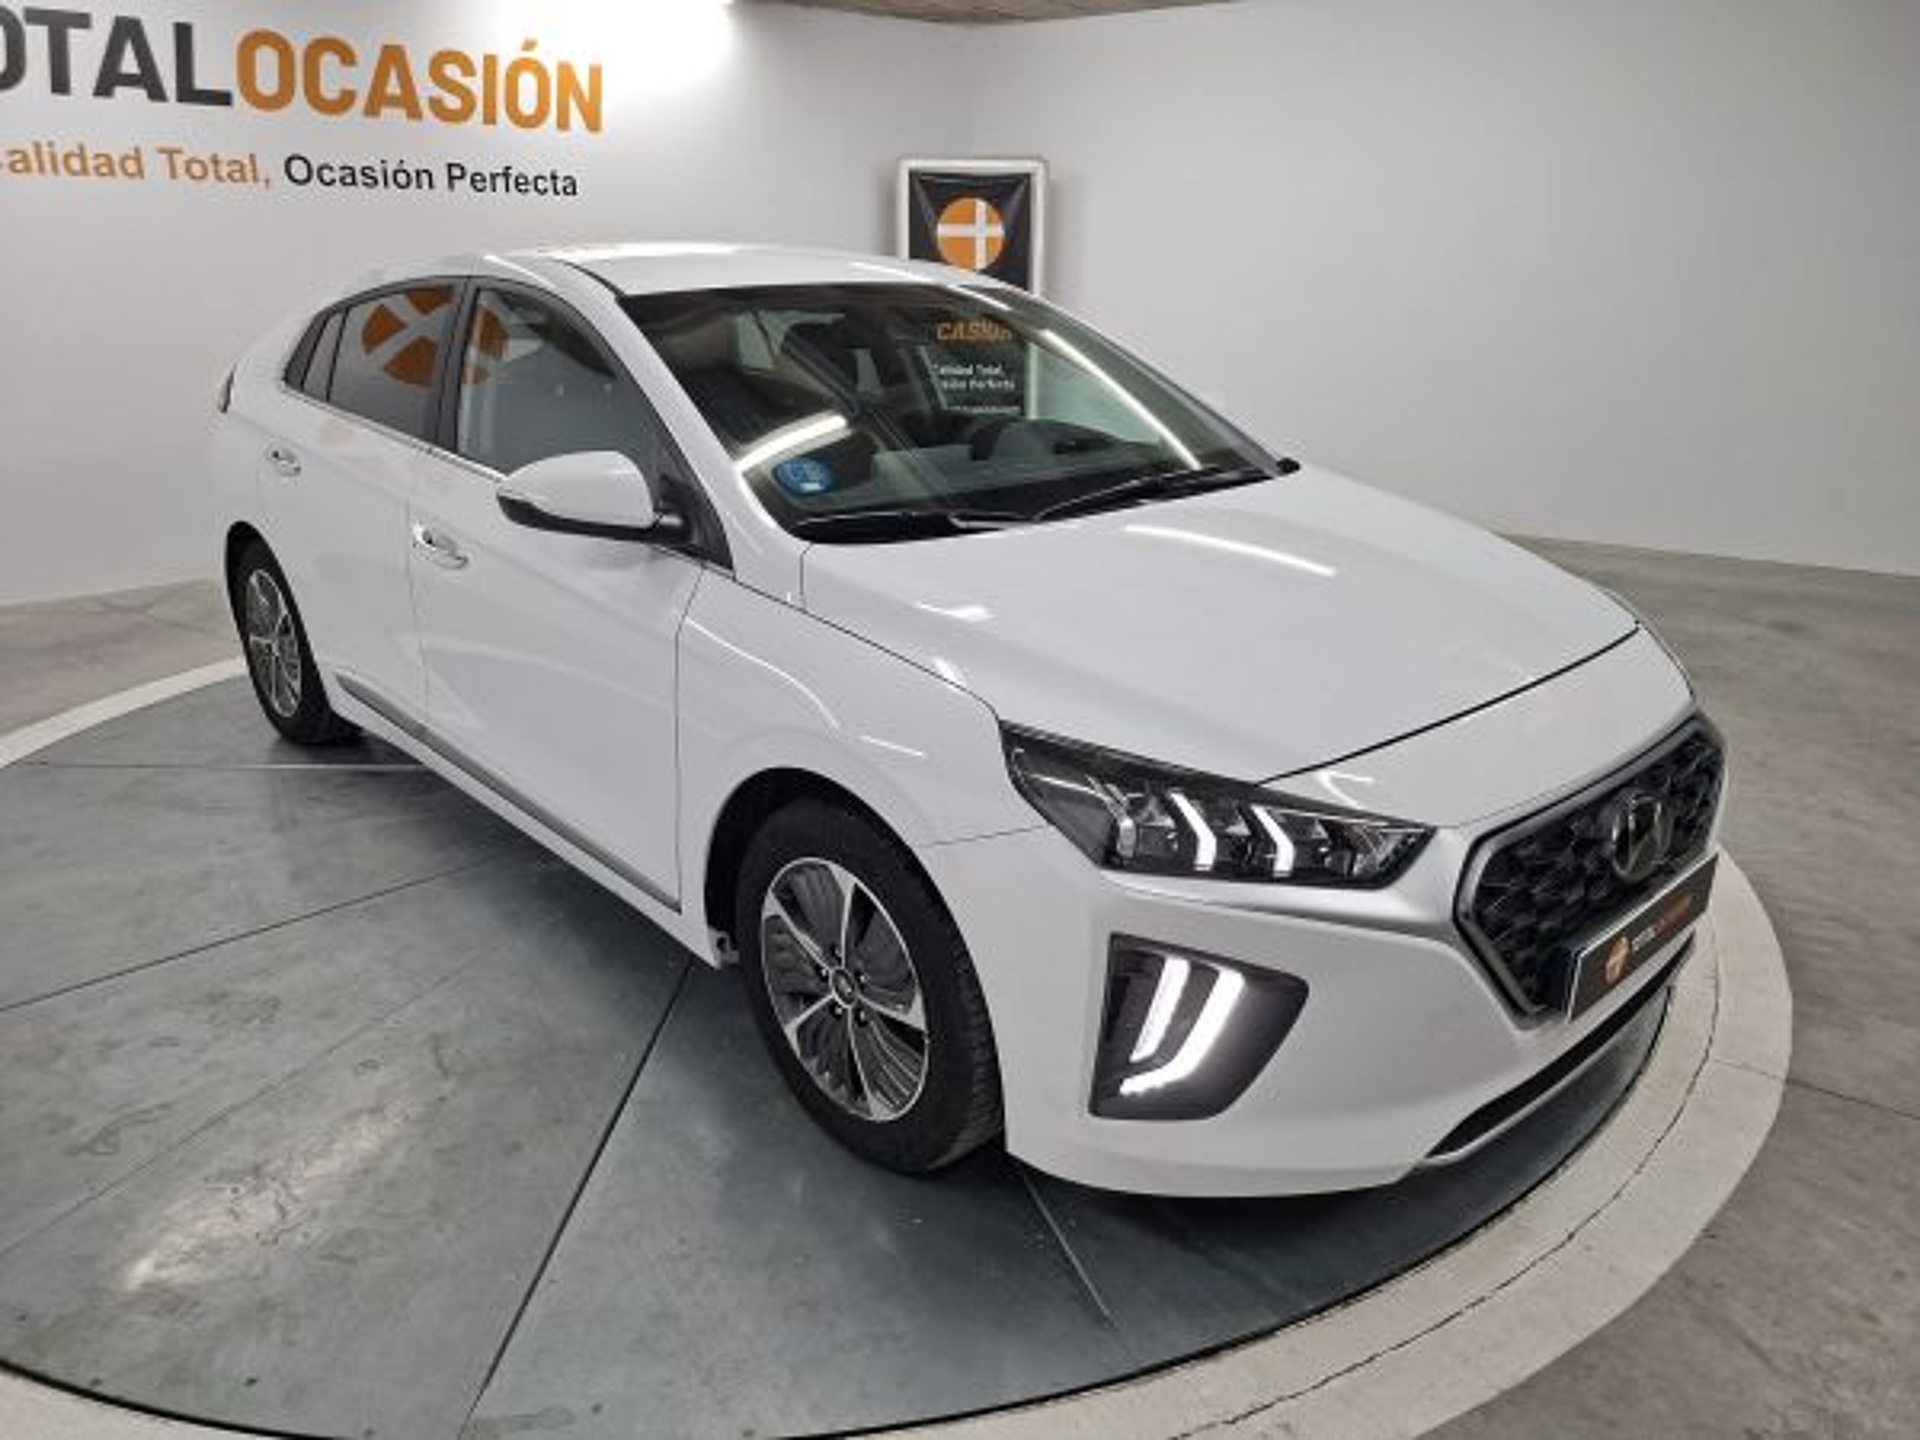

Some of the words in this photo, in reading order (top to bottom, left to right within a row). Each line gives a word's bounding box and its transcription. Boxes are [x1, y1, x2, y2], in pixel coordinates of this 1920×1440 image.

[0, 141, 145, 180] alidad
[156, 146, 270, 190] Total,
[284, 153, 435, 190] Ocasión
[446, 162, 578, 196] Perfecta
